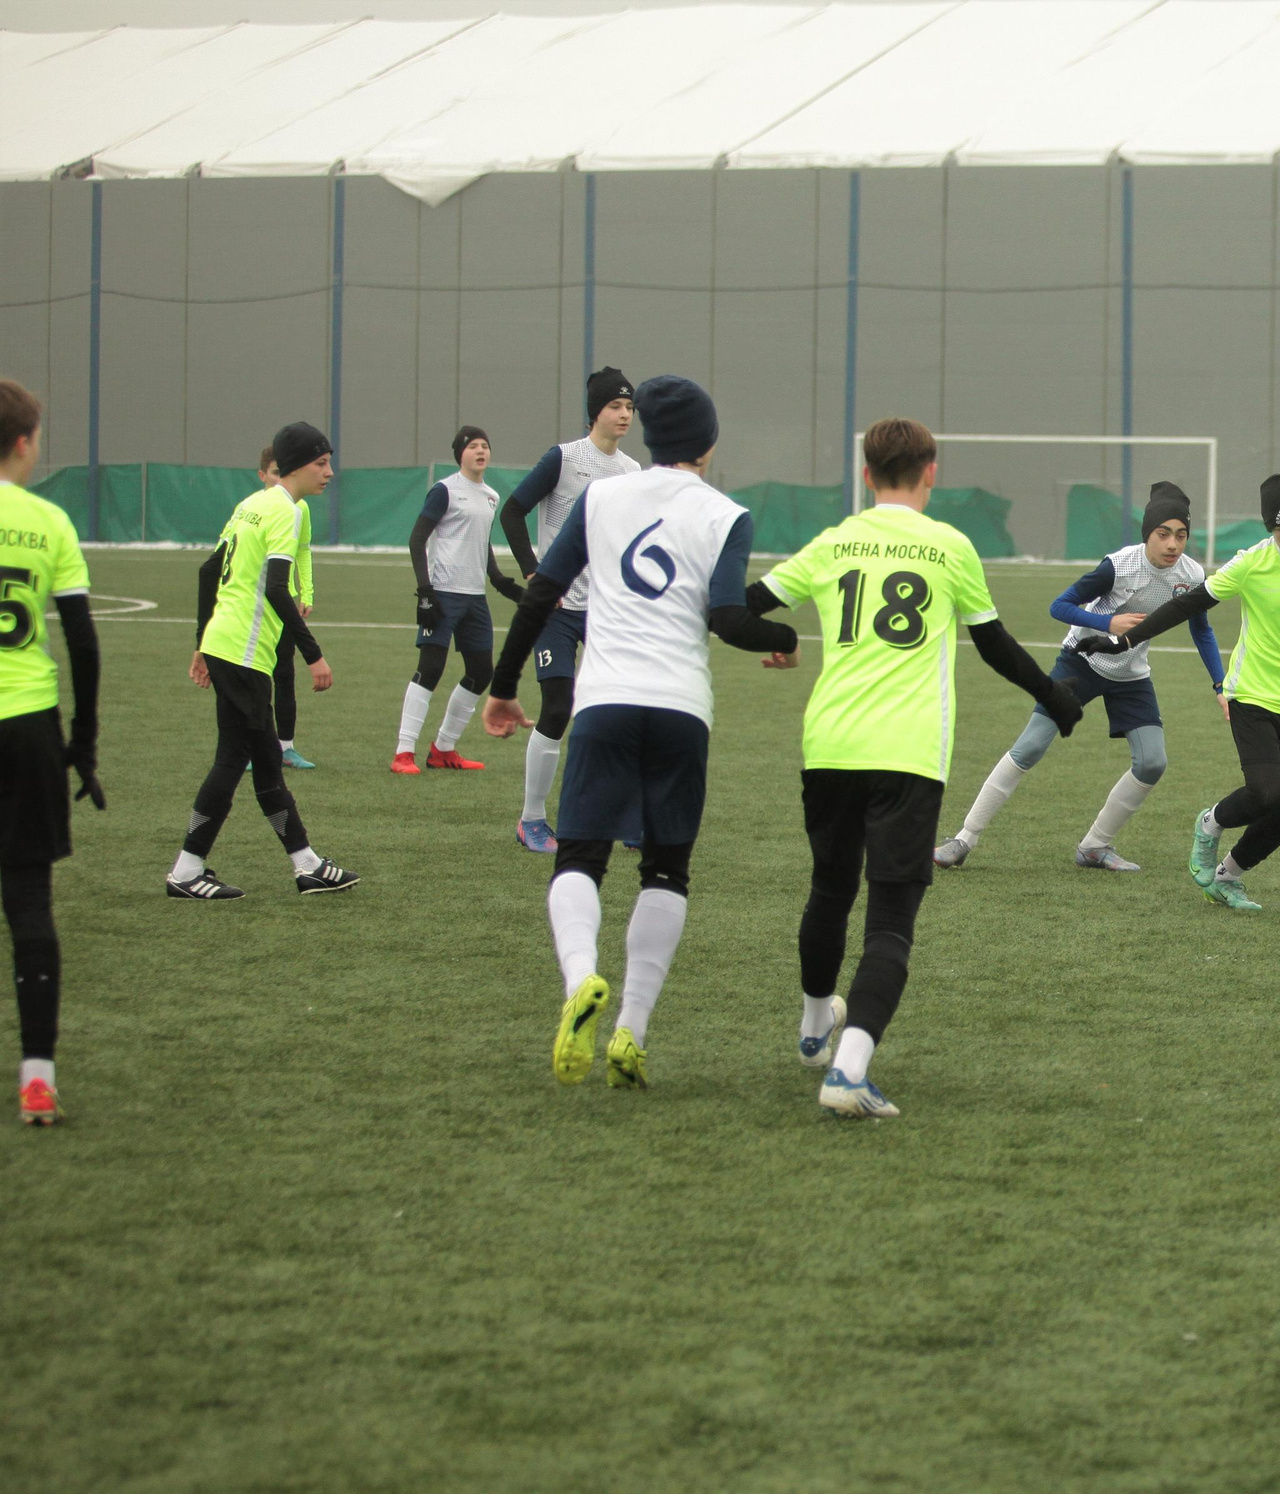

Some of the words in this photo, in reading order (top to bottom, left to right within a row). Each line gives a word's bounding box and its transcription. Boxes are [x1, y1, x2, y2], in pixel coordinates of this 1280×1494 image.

[0, 529, 49, 551] ОСКВА
[620, 517, 677, 600] 6
[834, 542, 880, 560] СМЕНА
[884, 544, 946, 568] МОСКВА
[837, 569, 932, 651] 18
[538, 650, 553, 667] 13
